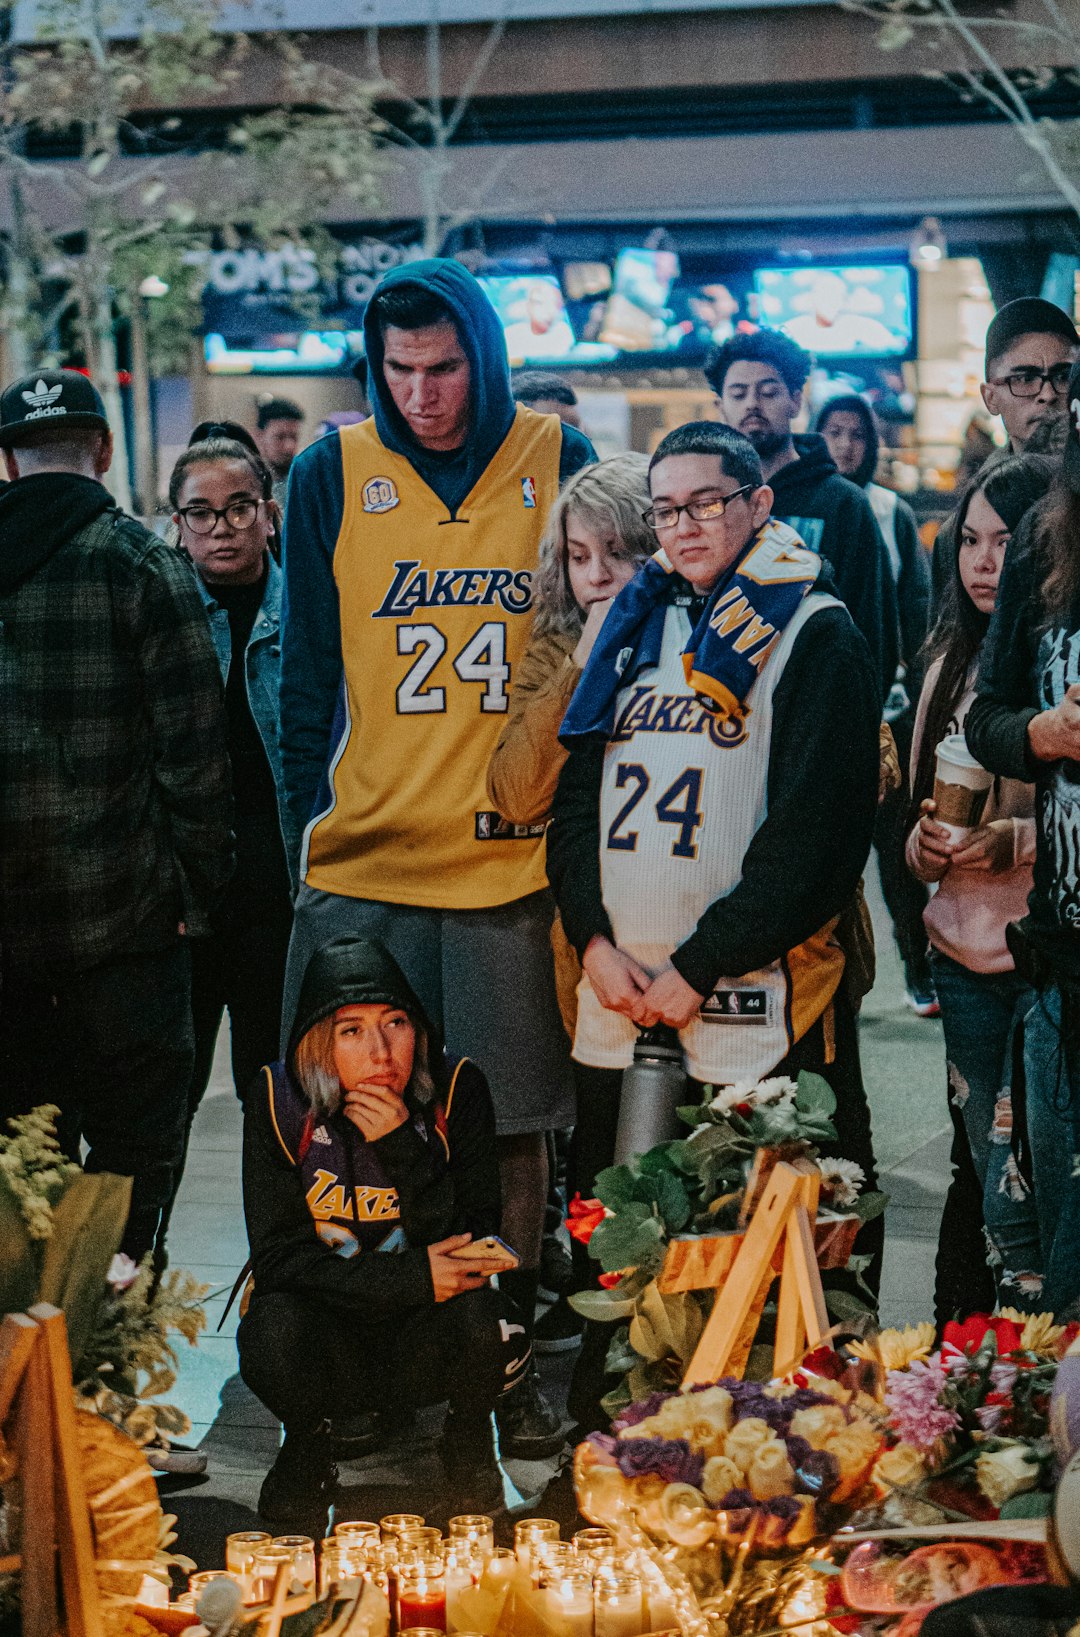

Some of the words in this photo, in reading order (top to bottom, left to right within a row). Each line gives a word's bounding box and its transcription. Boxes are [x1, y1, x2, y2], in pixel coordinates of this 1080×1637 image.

[24, 405, 67, 421] adidas
[368, 483, 391, 504] 60
[371, 560, 534, 618] LAKERS
[396, 622, 511, 714] 24
[606, 762, 706, 859] 24
[306, 1168, 400, 1222] LAKE
